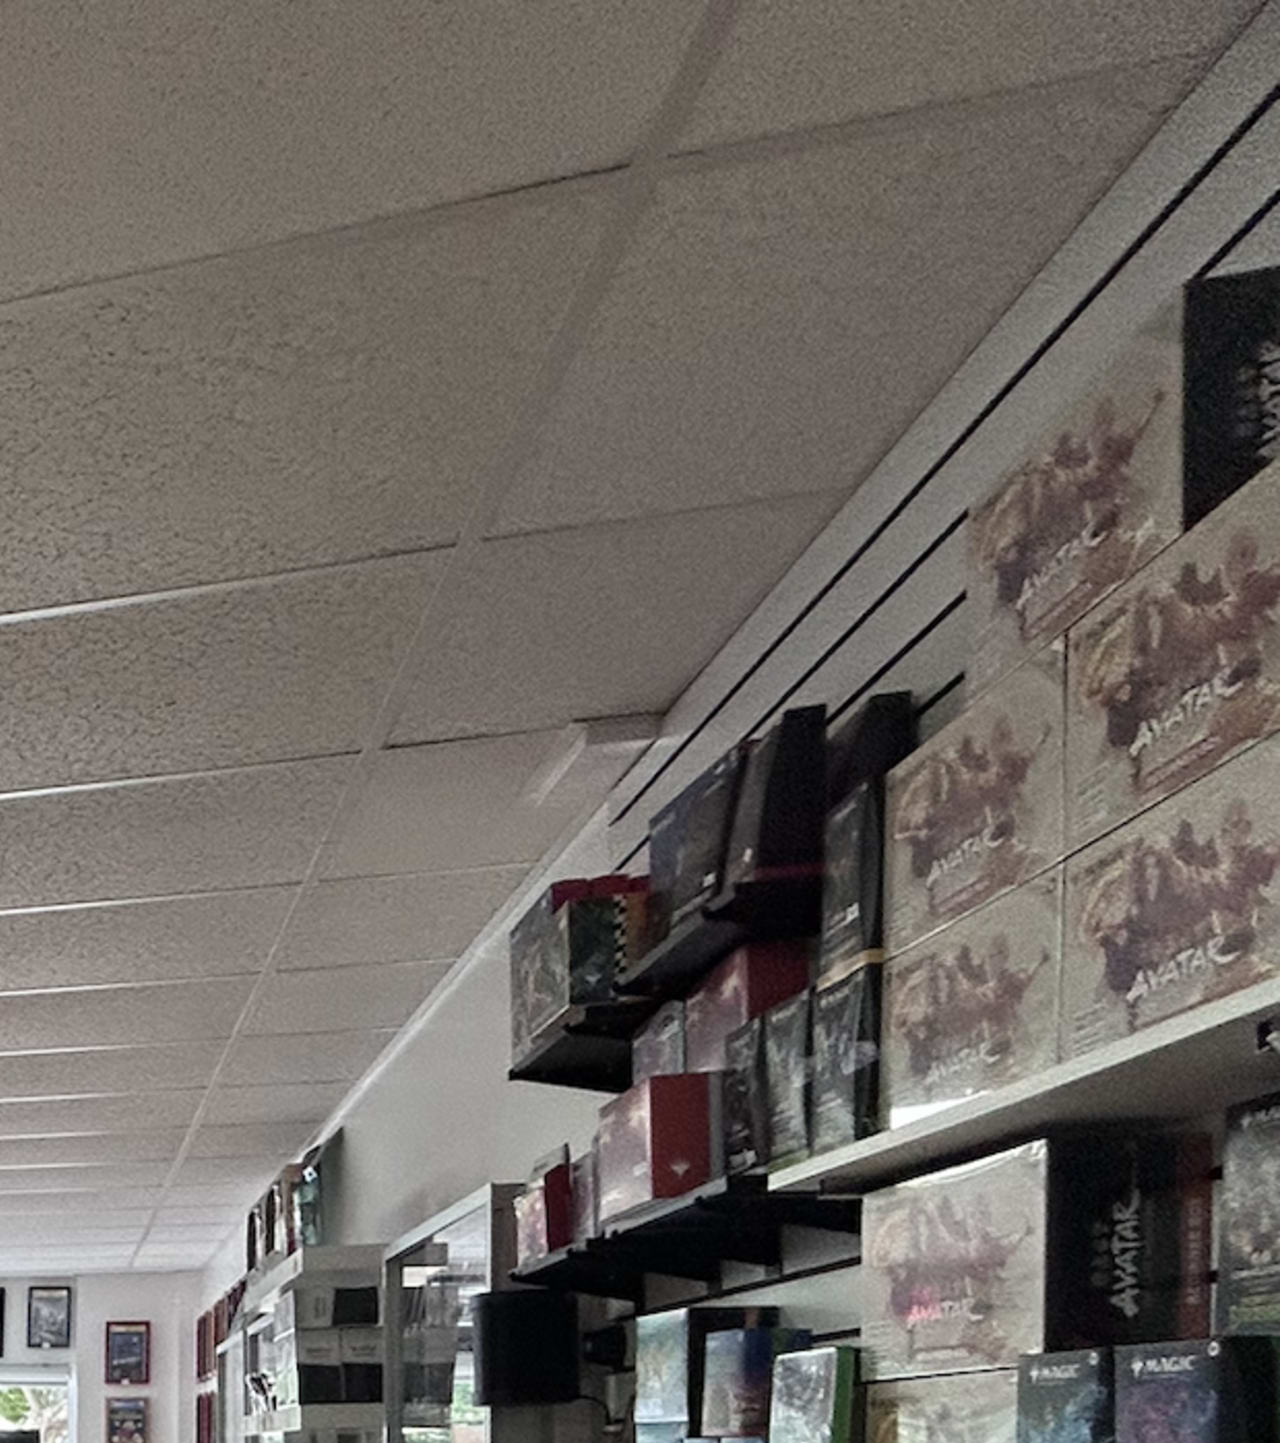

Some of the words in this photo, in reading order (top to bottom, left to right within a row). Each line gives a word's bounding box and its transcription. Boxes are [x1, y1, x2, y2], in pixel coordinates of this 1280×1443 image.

[1016, 526, 1108, 611] AVATAR
[1127, 669, 1243, 756] AVATAR
[926, 823, 1014, 888] AVATAR
[1126, 935, 1241, 1003] AVATAR
[922, 1040, 1002, 1087] AVATAR
[1108, 1188, 1144, 1318] AVATAR
[906, 1295, 986, 1329] AVATAR
[1038, 1362, 1083, 1379] MAGIC
[1144, 1354, 1198, 1374] MAGIC
